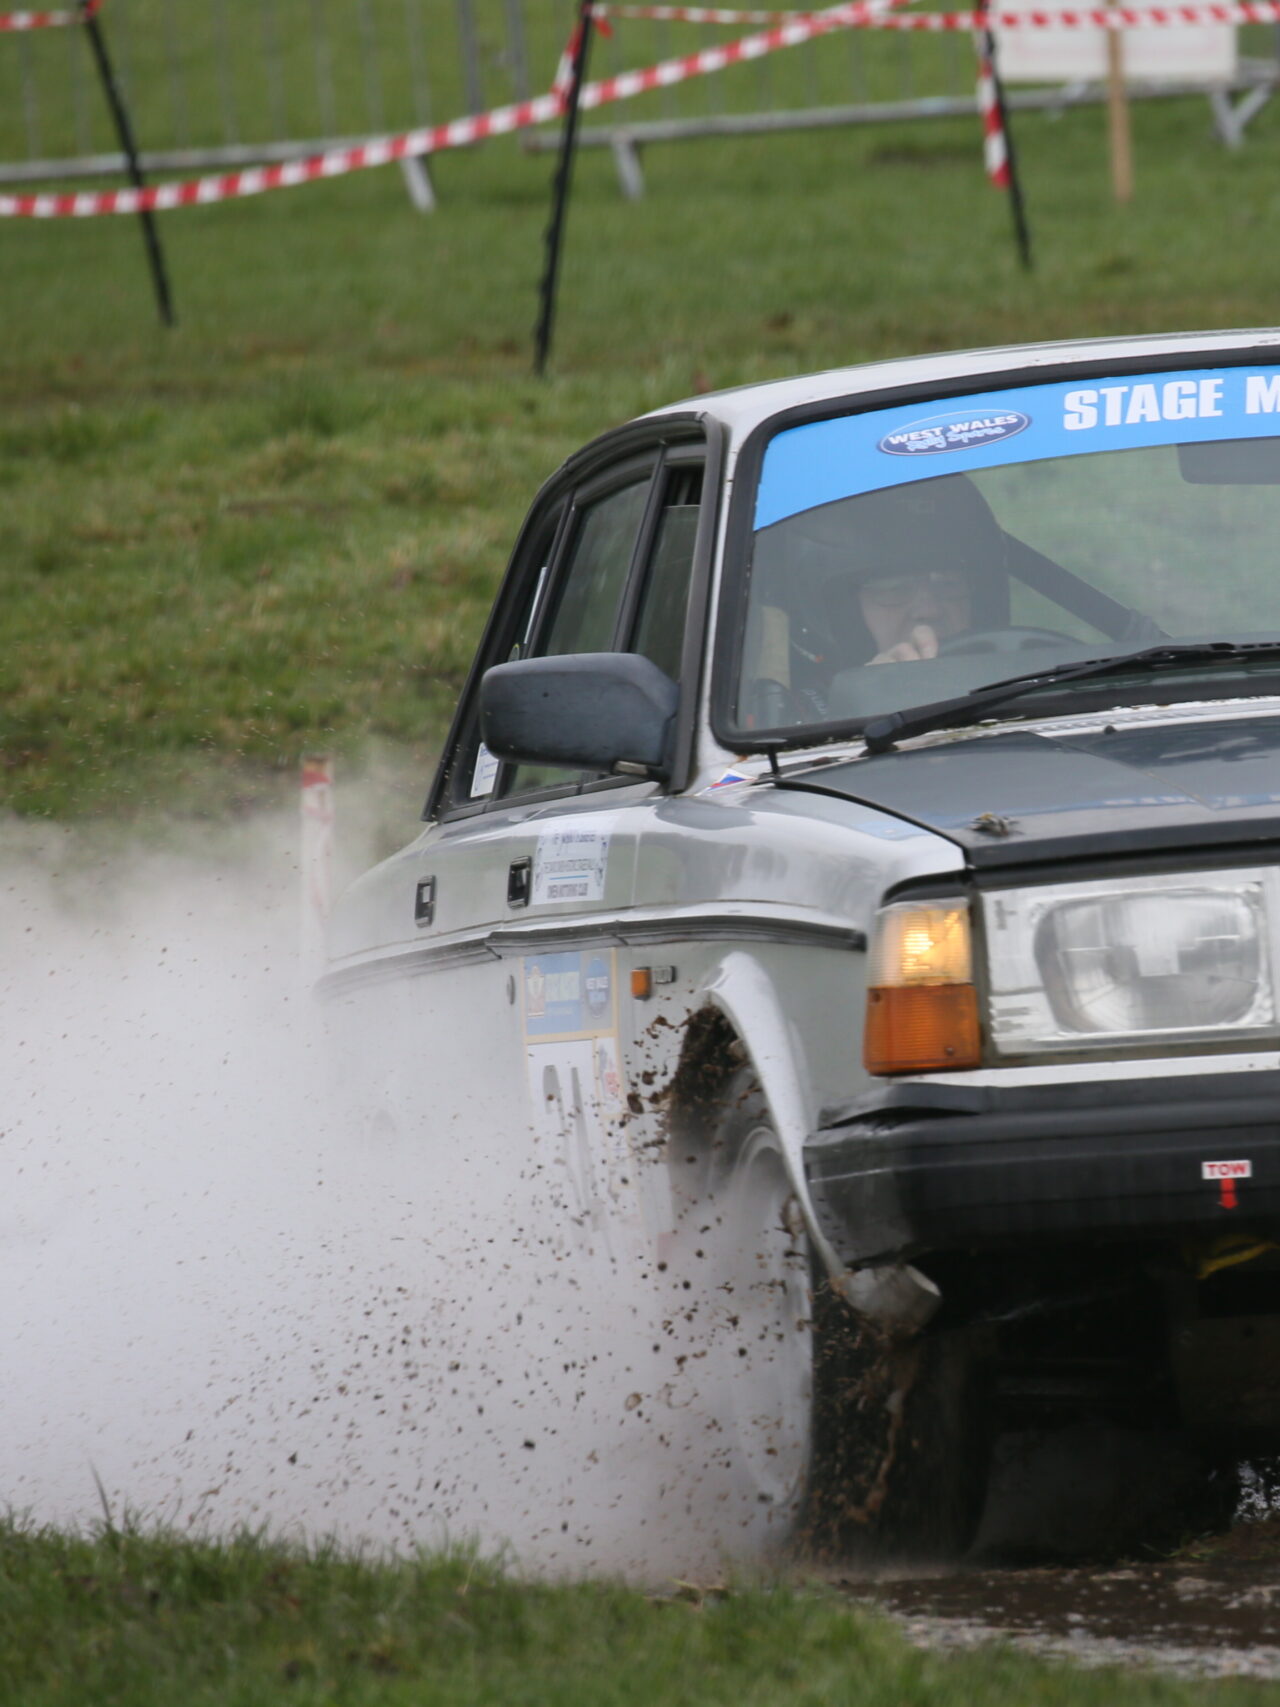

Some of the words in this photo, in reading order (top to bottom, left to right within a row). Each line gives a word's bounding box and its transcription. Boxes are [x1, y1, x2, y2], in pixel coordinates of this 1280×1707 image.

[1063, 379, 1224, 430] STAGE
[887, 426, 944, 445] WEST
[949, 415, 1019, 433] WALES
[1207, 1162, 1248, 1176] TOW
